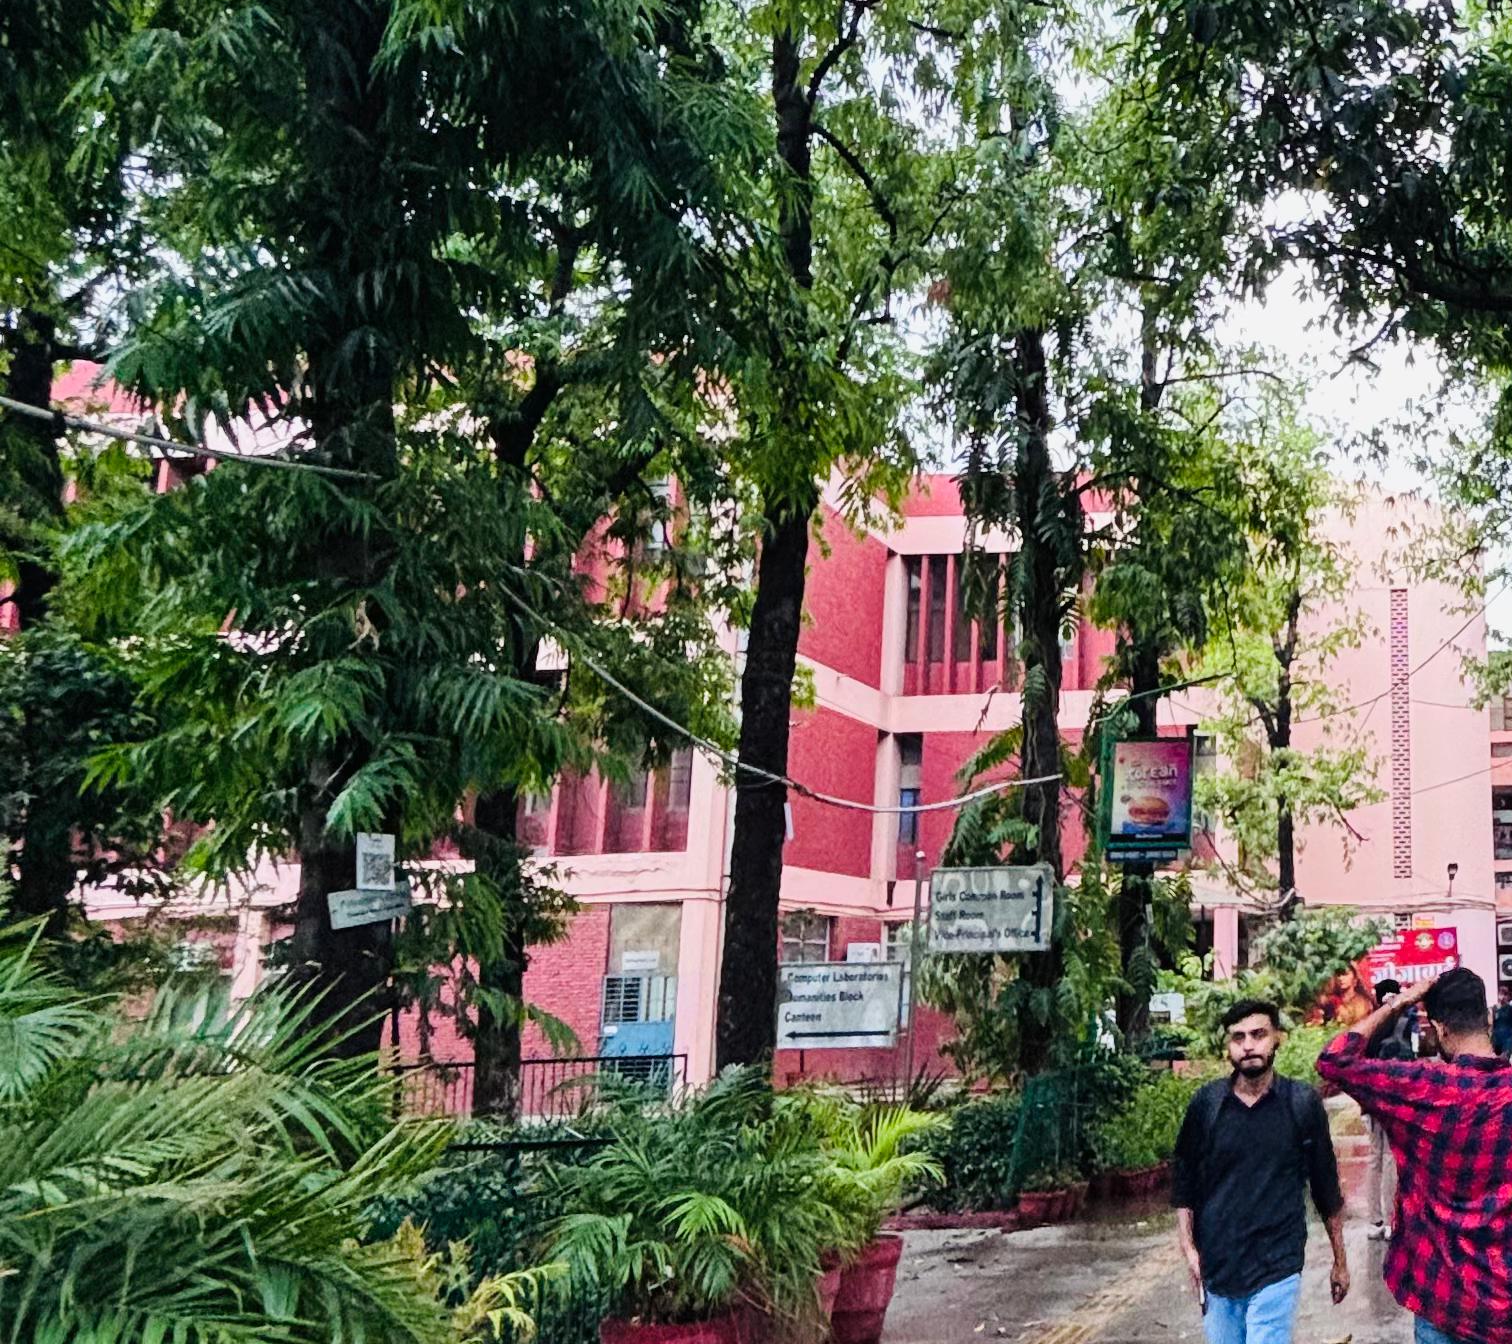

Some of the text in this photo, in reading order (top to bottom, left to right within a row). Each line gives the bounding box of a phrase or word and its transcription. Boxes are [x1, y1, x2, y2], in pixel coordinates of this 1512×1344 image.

[936, 890, 1024, 903] Girls Common Room
[935, 909, 984, 921] Staff Room
[1004, 927, 1029, 938] Office
[788, 971, 888, 984] Computer Laboratories
[839, 990, 864, 1002] Block
[784, 1011, 822, 1023] Canteen
